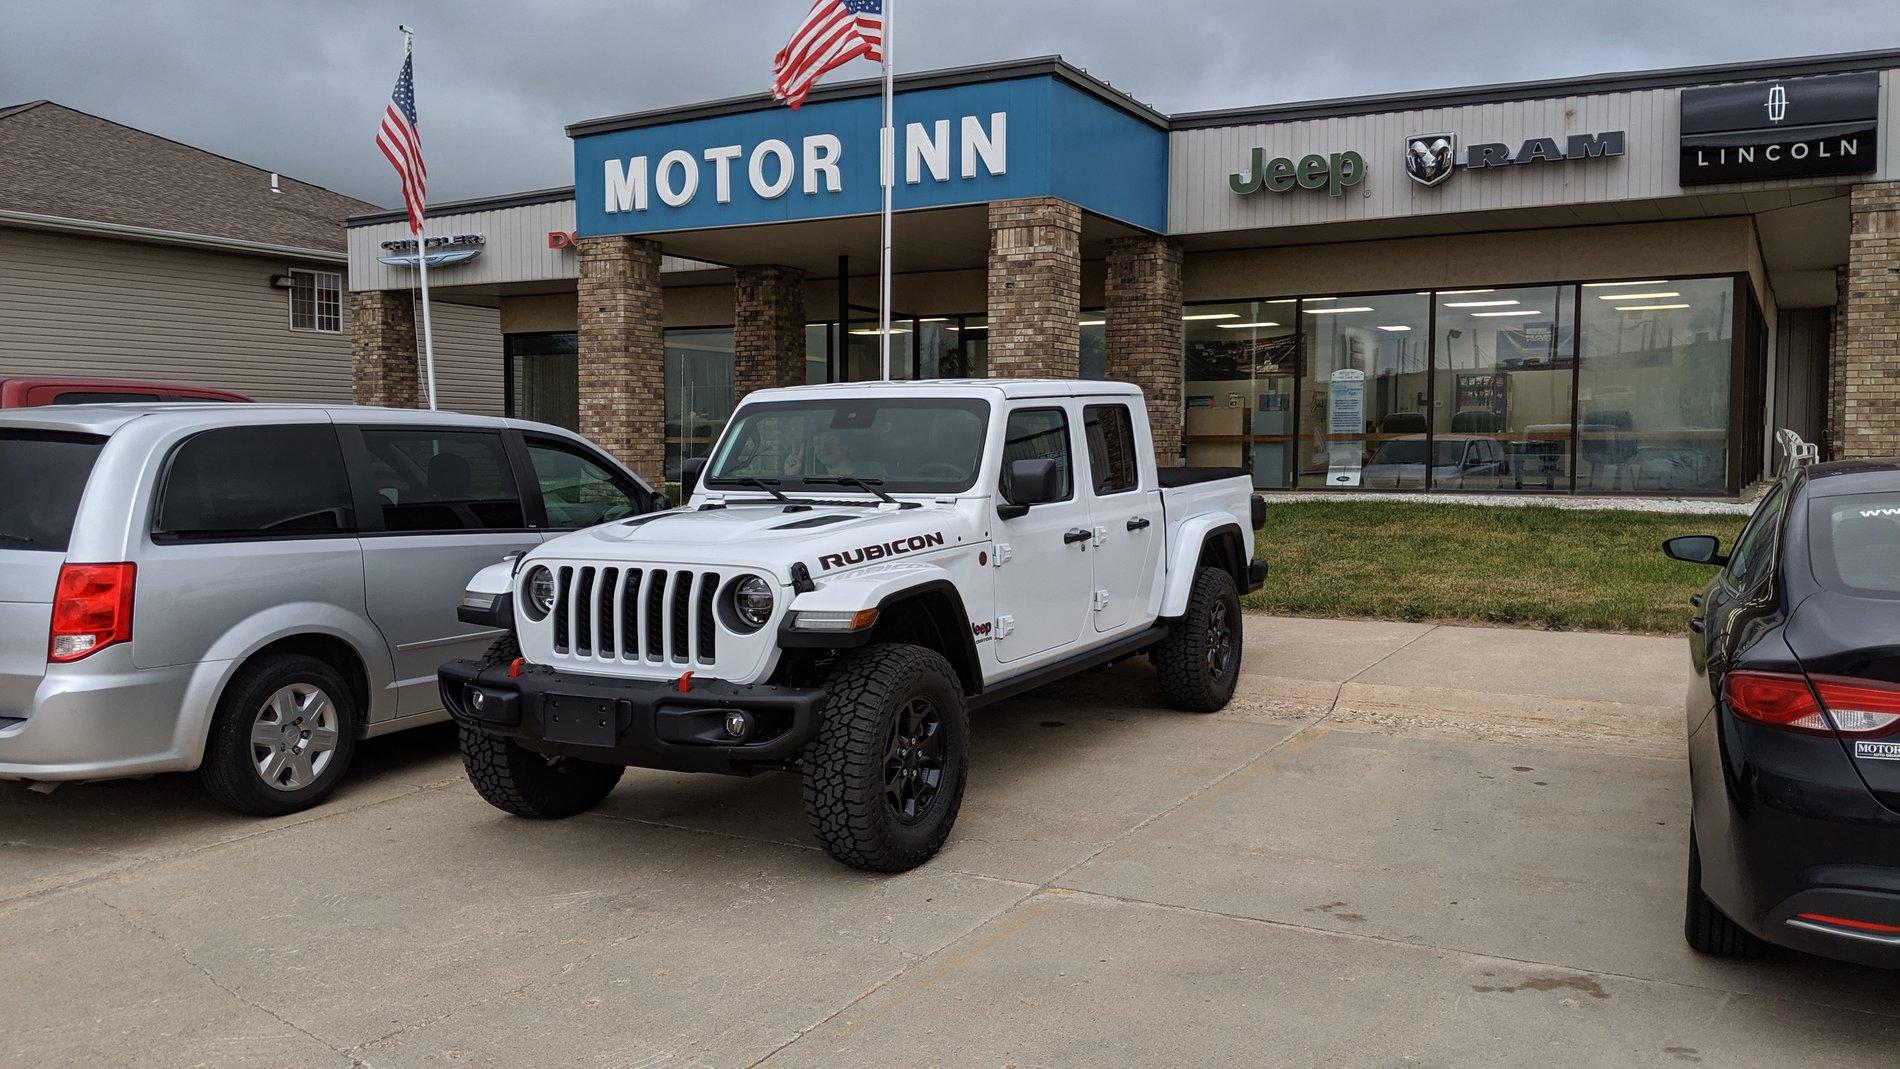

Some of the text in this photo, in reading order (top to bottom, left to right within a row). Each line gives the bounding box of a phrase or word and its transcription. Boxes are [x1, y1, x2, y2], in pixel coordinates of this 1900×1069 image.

[604, 111, 1006, 213] MOTOR INN
[1467, 131, 1626, 169] RAM
[1698, 139, 1858, 166] LINCOLN
[1229, 147, 1365, 197] Jeep
[818, 531, 944, 570] RUBICON
